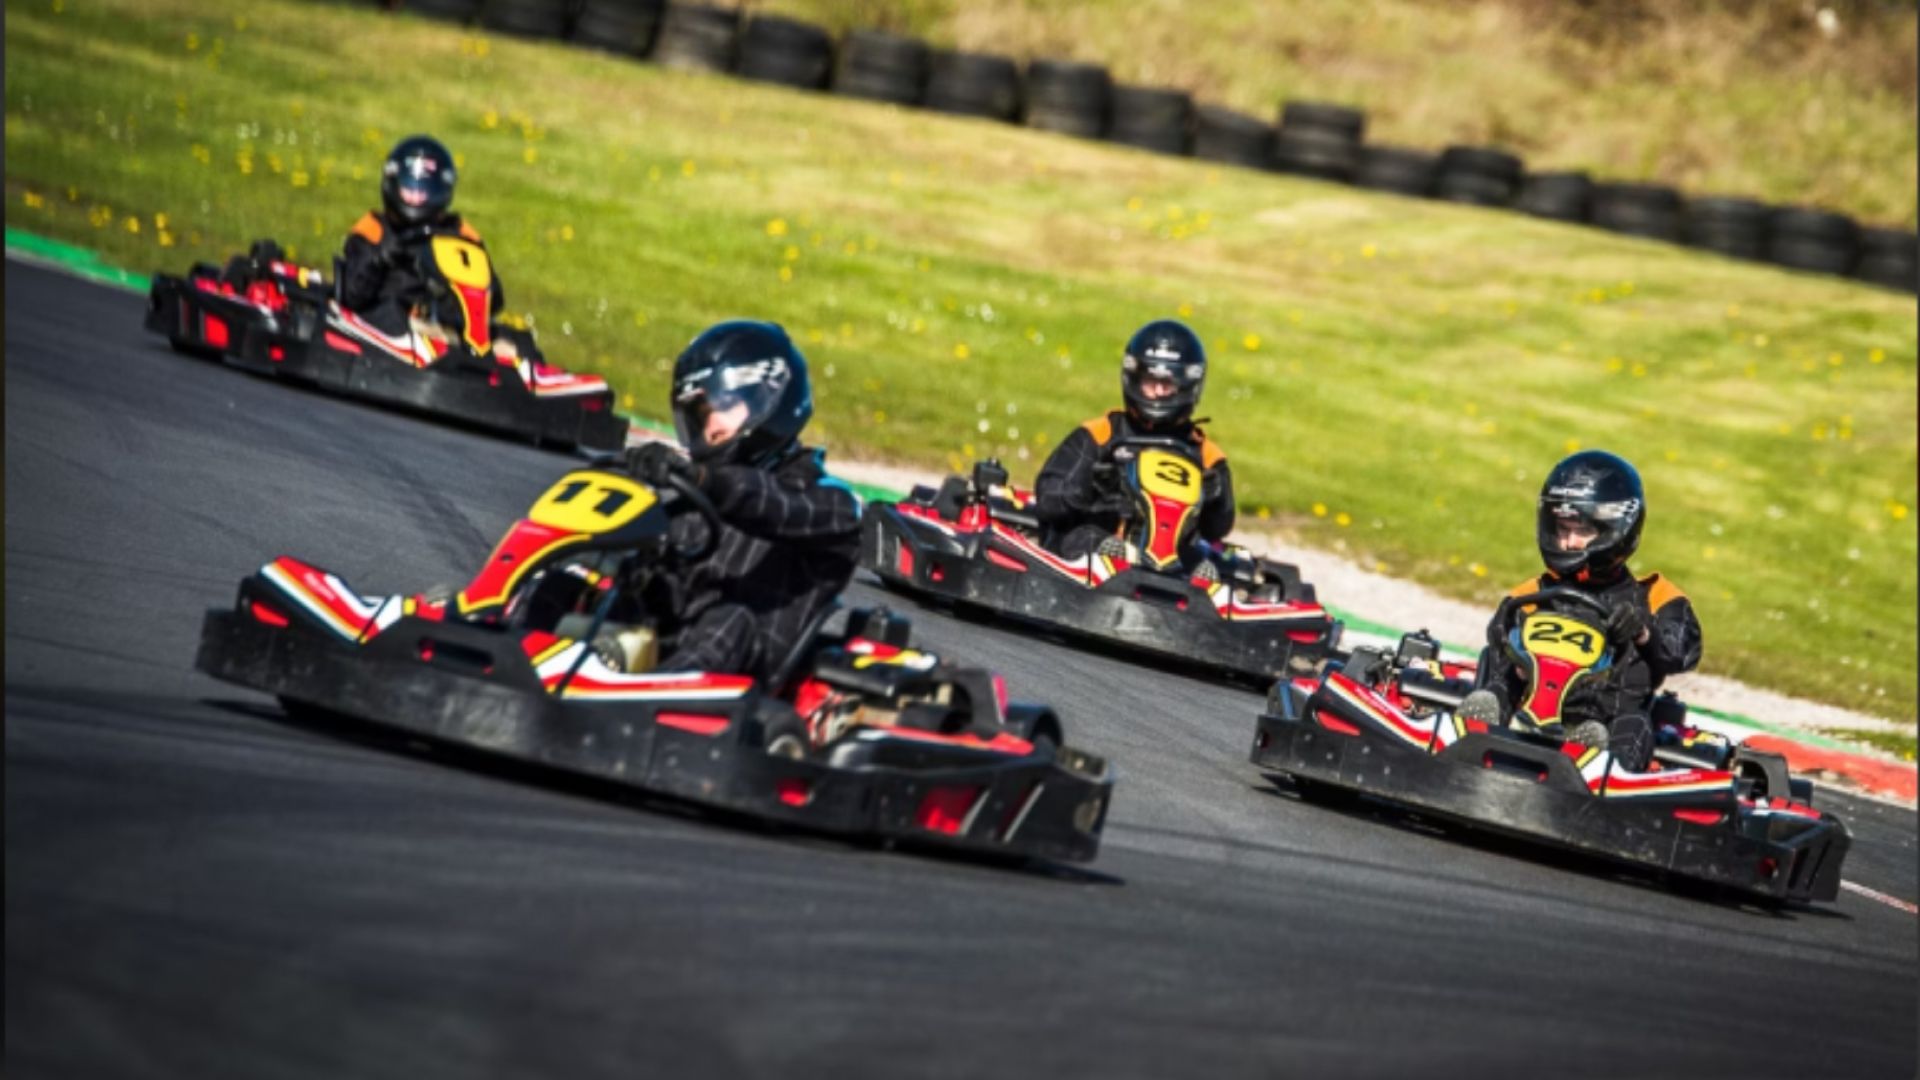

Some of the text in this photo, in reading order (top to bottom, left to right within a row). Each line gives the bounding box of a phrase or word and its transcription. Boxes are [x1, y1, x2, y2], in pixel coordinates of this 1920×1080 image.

[456, 248, 471, 268] 1
[1155, 461, 1190, 486] 3
[552, 480, 633, 517] 11
[1529, 622, 1594, 653] 24
